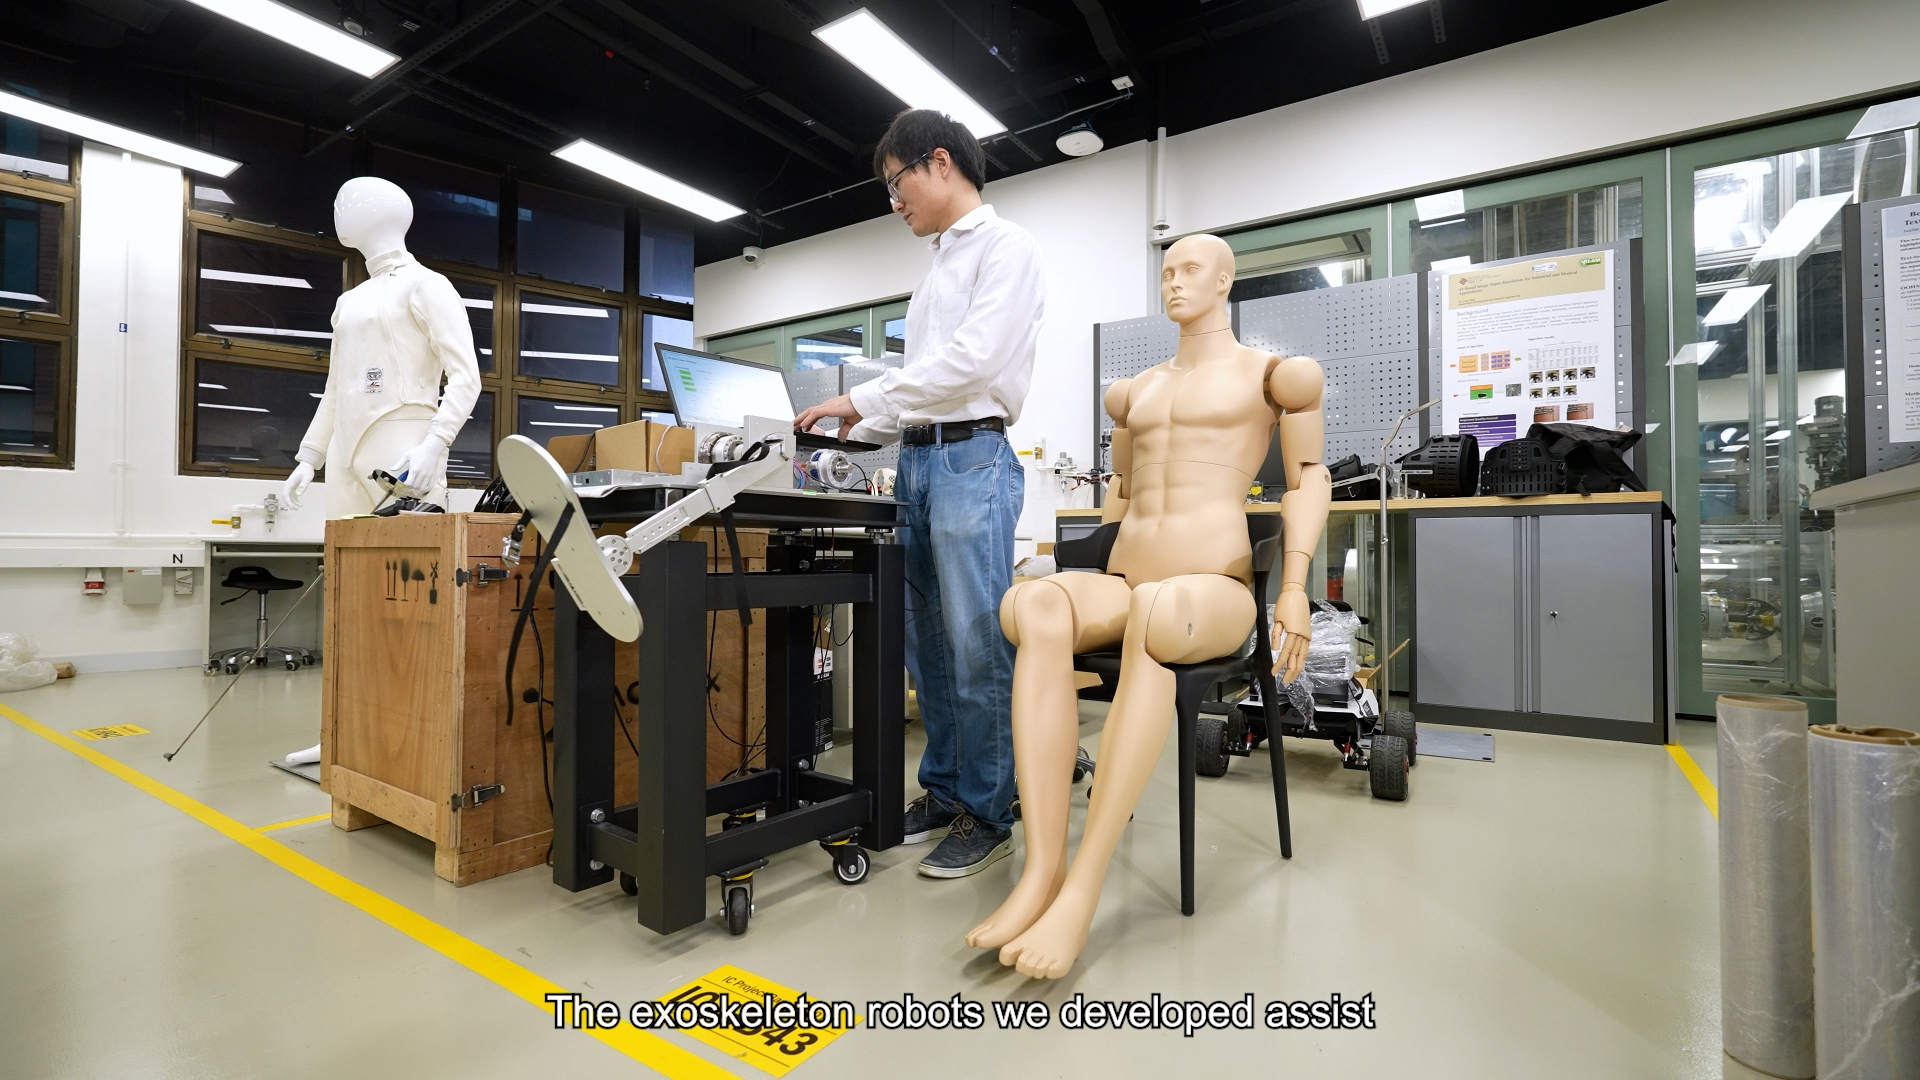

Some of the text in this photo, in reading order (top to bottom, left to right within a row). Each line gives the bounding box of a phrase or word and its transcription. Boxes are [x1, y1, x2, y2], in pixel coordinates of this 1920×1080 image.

[173, 554, 183, 564] N
[722, 976, 767, 998] IC Projec
